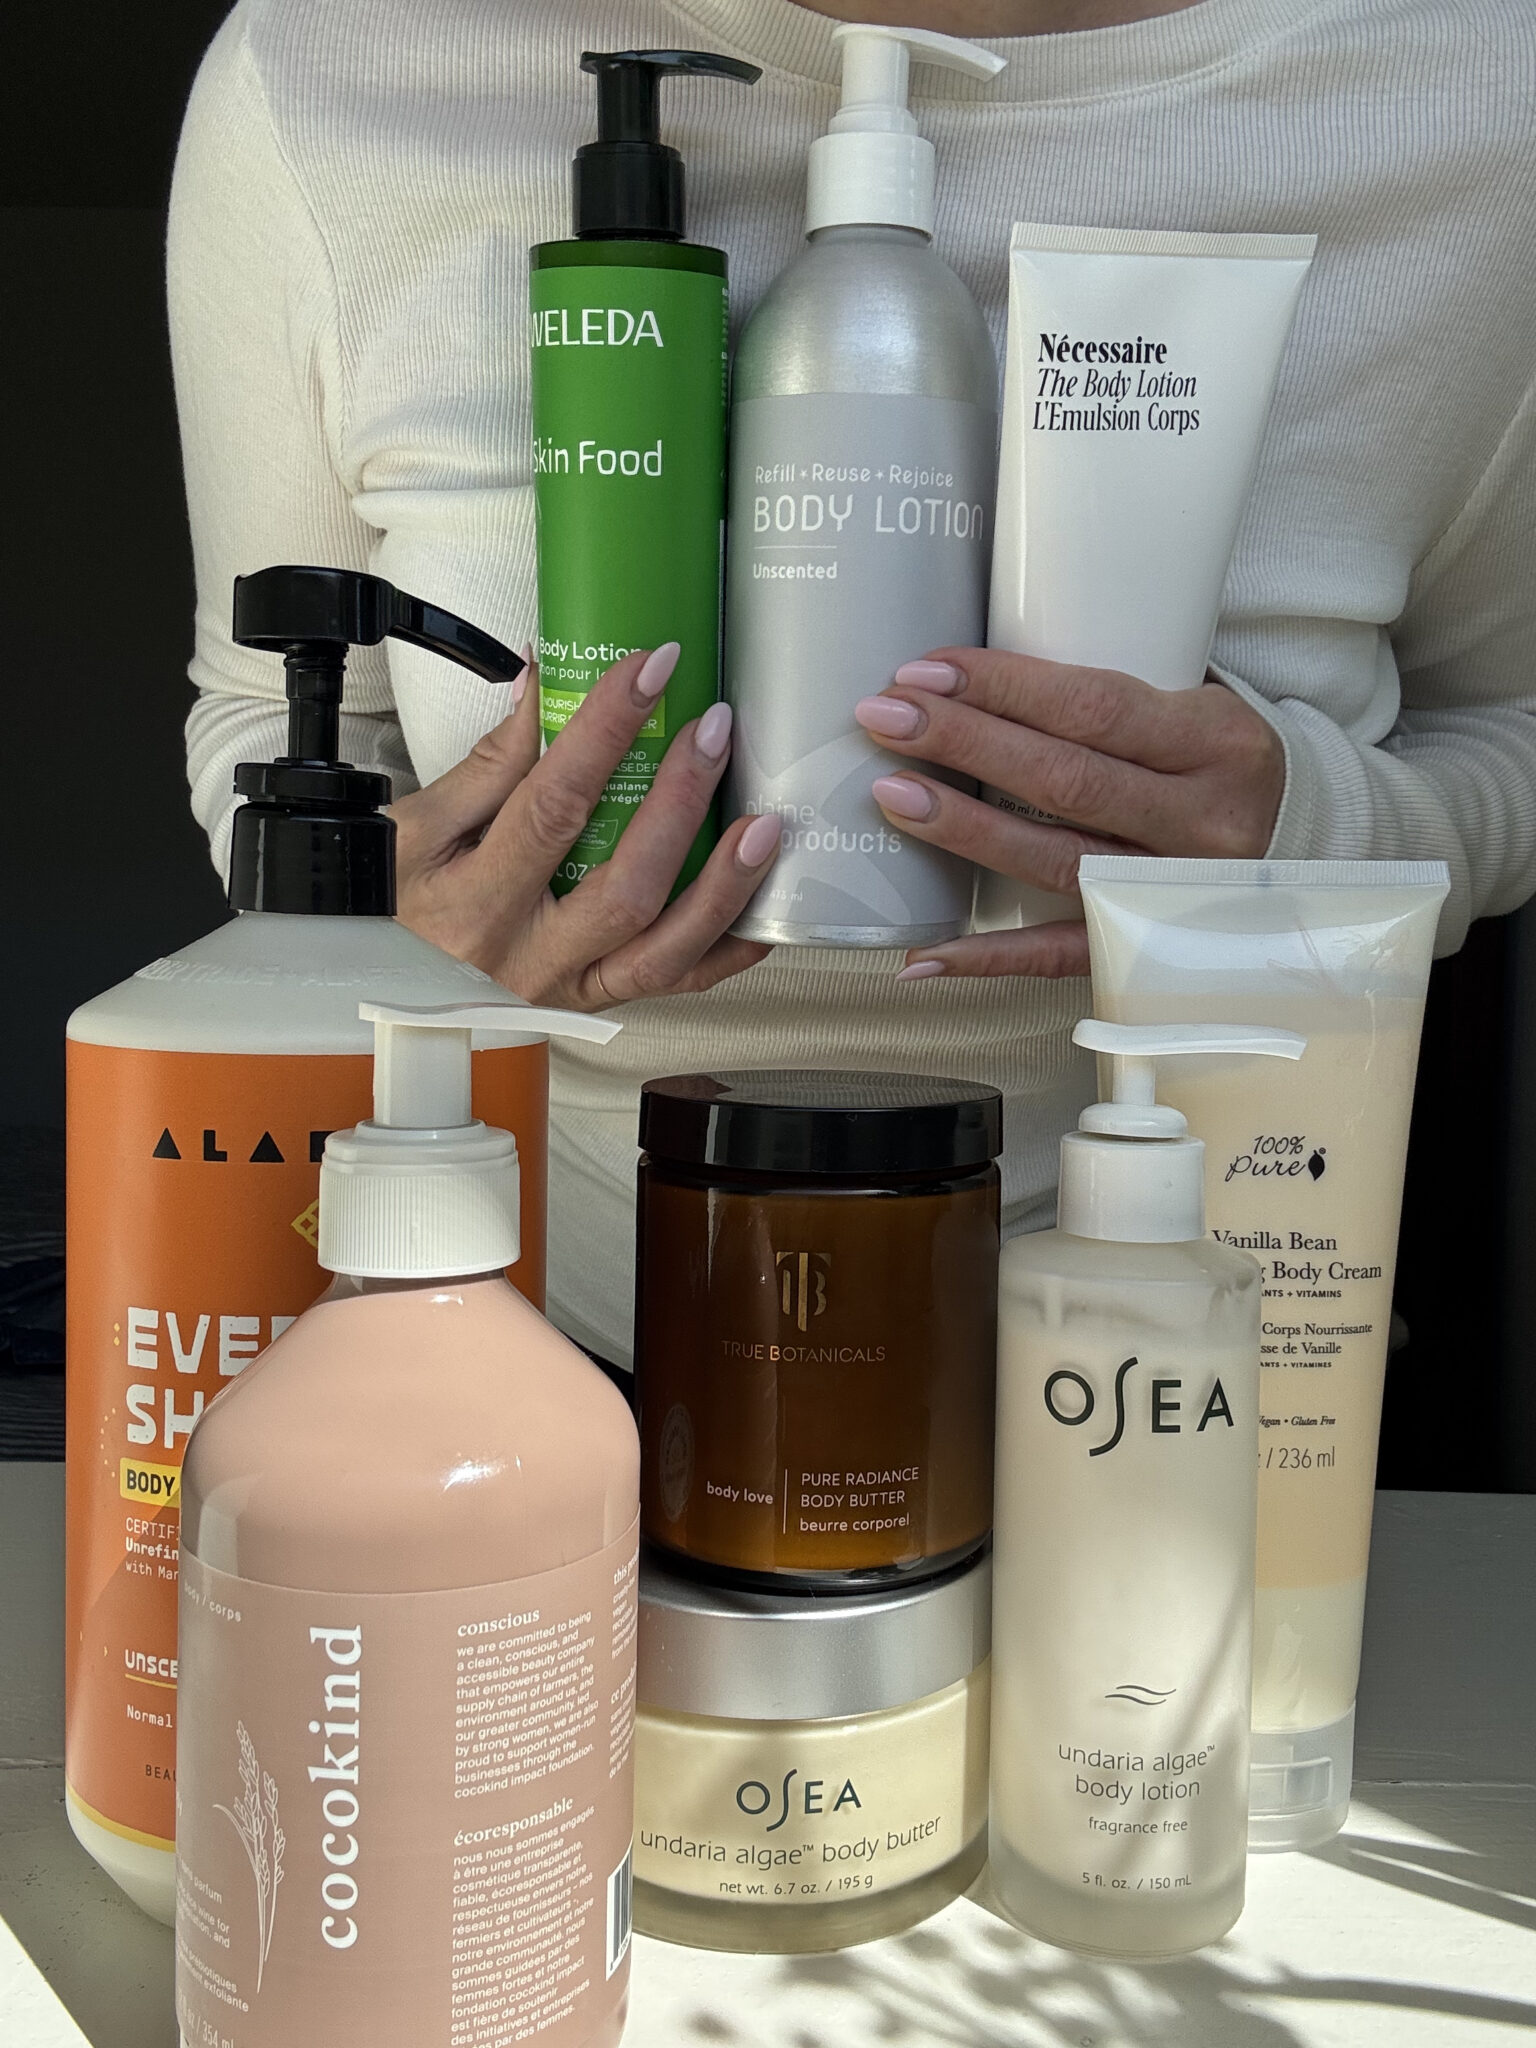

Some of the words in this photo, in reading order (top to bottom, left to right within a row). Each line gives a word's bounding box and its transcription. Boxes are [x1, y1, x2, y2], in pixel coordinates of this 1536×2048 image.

[1037, 333, 1167, 364] Nécessaire
[1037, 368, 1078, 397] The
[1083, 368, 1131, 403] Body
[1136, 369, 1197, 398] Lotion
[1033, 401, 1140, 431] L'Emulsion
[1148, 402, 1200, 435] Corps
[533, 437, 569, 473] Skin
[579, 440, 662, 477] Food
[755, 463, 795, 484] Refill
[812, 463, 871, 482] Reuse
[889, 464, 953, 488] Rejoice
[754, 494, 853, 533] BODY
[753, 561, 837, 580] Unscented
[540, 637, 568, 661] Body
[559, 668, 591, 680] pour
[607, 781, 649, 791] ualane
[611, 793, 645, 805] végét
[999, 798, 1016, 811] 200
[780, 826, 901, 854] products
[1253, 1135, 1306, 1155] 100%
[1211, 1230, 1282, 1250] Vanilla
[1289, 1232, 1337, 1250] Bean
[1272, 1261, 1322, 1285] Body
[1329, 1261, 1382, 1281] Cream
[1296, 1289, 1342, 1298] VITAMINS
[127, 1306, 298, 1376] EVE
[1262, 1322, 1301, 1338] Corps
[1305, 1323, 1373, 1336] Nourrissante
[721, 1341, 764, 1360] TRUE
[769, 1345, 886, 1362] BOTANICALS
[1260, 1345, 1279, 1354] sse
[1282, 1342, 1297, 1354] de
[1301, 1342, 1342, 1355] Vanille
[126, 1384, 204, 1449] SH
[1044, 1356, 1234, 1457] OSEA
[1291, 1416, 1318, 1426] Gluten
[1279, 1448, 1312, 1469] 236
[1317, 1446, 1335, 1467] ml
[126, 1468, 175, 1497] BODY
[801, 1473, 840, 1486] PURE
[845, 1467, 919, 1486] RADIANCE
[707, 1481, 739, 1502] body
[744, 1488, 773, 1505] love
[801, 1494, 845, 1508] BODY
[849, 1490, 905, 1507] BUTTER
[800, 1518, 847, 1532] beurre
[852, 1512, 909, 1532] corporel
[125, 1536, 179, 1561] Unrefin
[125, 1560, 152, 1577] with
[158, 1566, 179, 1581] Mar
[209, 1601, 242, 1622] corps
[458, 1610, 540, 1637] conscious
[457, 1644, 473, 1657] we
[477, 1643, 495, 1654] are
[499, 1627, 555, 1650] committed
[558, 1622, 566, 1633] to
[568, 1611, 591, 1630] being
[125, 1648, 178, 1679] UNSCE
[456, 1662, 519, 1685] accessible
[522, 1655, 555, 1671] beauty
[557, 1636, 595, 1660] company
[457, 1662, 464, 1671] a
[468, 1653, 502, 1670] clean,
[505, 1640, 560, 1662] conscious,
[562, 1630, 578, 1645] and
[456, 1686, 479, 1699] that
[483, 1671, 540, 1695] empowers
[542, 1667, 557, 1679] our
[560, 1655, 584, 1673] entire
[456, 1698, 495, 1713] supply
[498, 1690, 527, 1706] chain
[530, 1686, 540, 1697] of
[542, 1672, 579, 1694] farmers,
[581, 1664, 593, 1676] the
[456, 1704, 527, 1728] environment
[530, 1693, 563, 1712] around
[580, 1676, 594, 1690] and
[127, 1704, 173, 1729] Normal
[456, 1731, 474, 1742] our
[479, 1722, 518, 1740] greater
[578, 1691, 589, 1705] led
[456, 1746, 469, 1757] by
[473, 1738, 509, 1752] strong
[512, 1725, 551, 1744] women,
[554, 1718, 566, 1730] we
[569, 1712, 581, 1723] are
[583, 1701, 598, 1716] also
[455, 1754, 490, 1772] proud
[493, 1751, 504, 1762] to
[508, 1737, 547, 1759] support
[550, 1715, 596, 1744] women-run
[1058, 1743, 1144, 1771] undaria
[455, 1761, 520, 1784] businesses
[523, 1748, 560, 1769] through
[563, 1740, 576, 1752] the
[307, 1624, 362, 1949] cocokind
[454, 1778, 508, 1799] cocokind
[511, 1768, 547, 1785] impact
[1076, 1774, 1133, 1805] body
[1142, 1781, 1200, 1801] lotion
[736, 1768, 862, 1832] OSEA
[454, 1798, 573, 1846] écoresponsable
[1089, 1816, 1158, 1835] fragrance
[1163, 1820, 1188, 1833] free
[640, 1829, 726, 1863] undaria
[823, 1837, 879, 1863] body
[887, 1816, 941, 1851] butter
[719, 1880, 742, 1895] net
[747, 1882, 768, 1895] wt.
[774, 1881, 796, 1896] 6.7
[801, 1882, 821, 1895] oz.
[838, 1876, 860, 1890] 195
[865, 1875, 873, 1889] g
[1082, 1872, 1090, 1884] 5
[1095, 1874, 1106, 1887] fl.
[1111, 1878, 1130, 1889] oz.
[1150, 1877, 1171, 1890] 150
[1174, 1874, 1192, 1888] mL
[217, 1917, 230, 1934] for
[213, 1932, 230, 1949] and
[204, 1979, 249, 2013] exfoliante
[202, 2020, 218, 2048] 354
